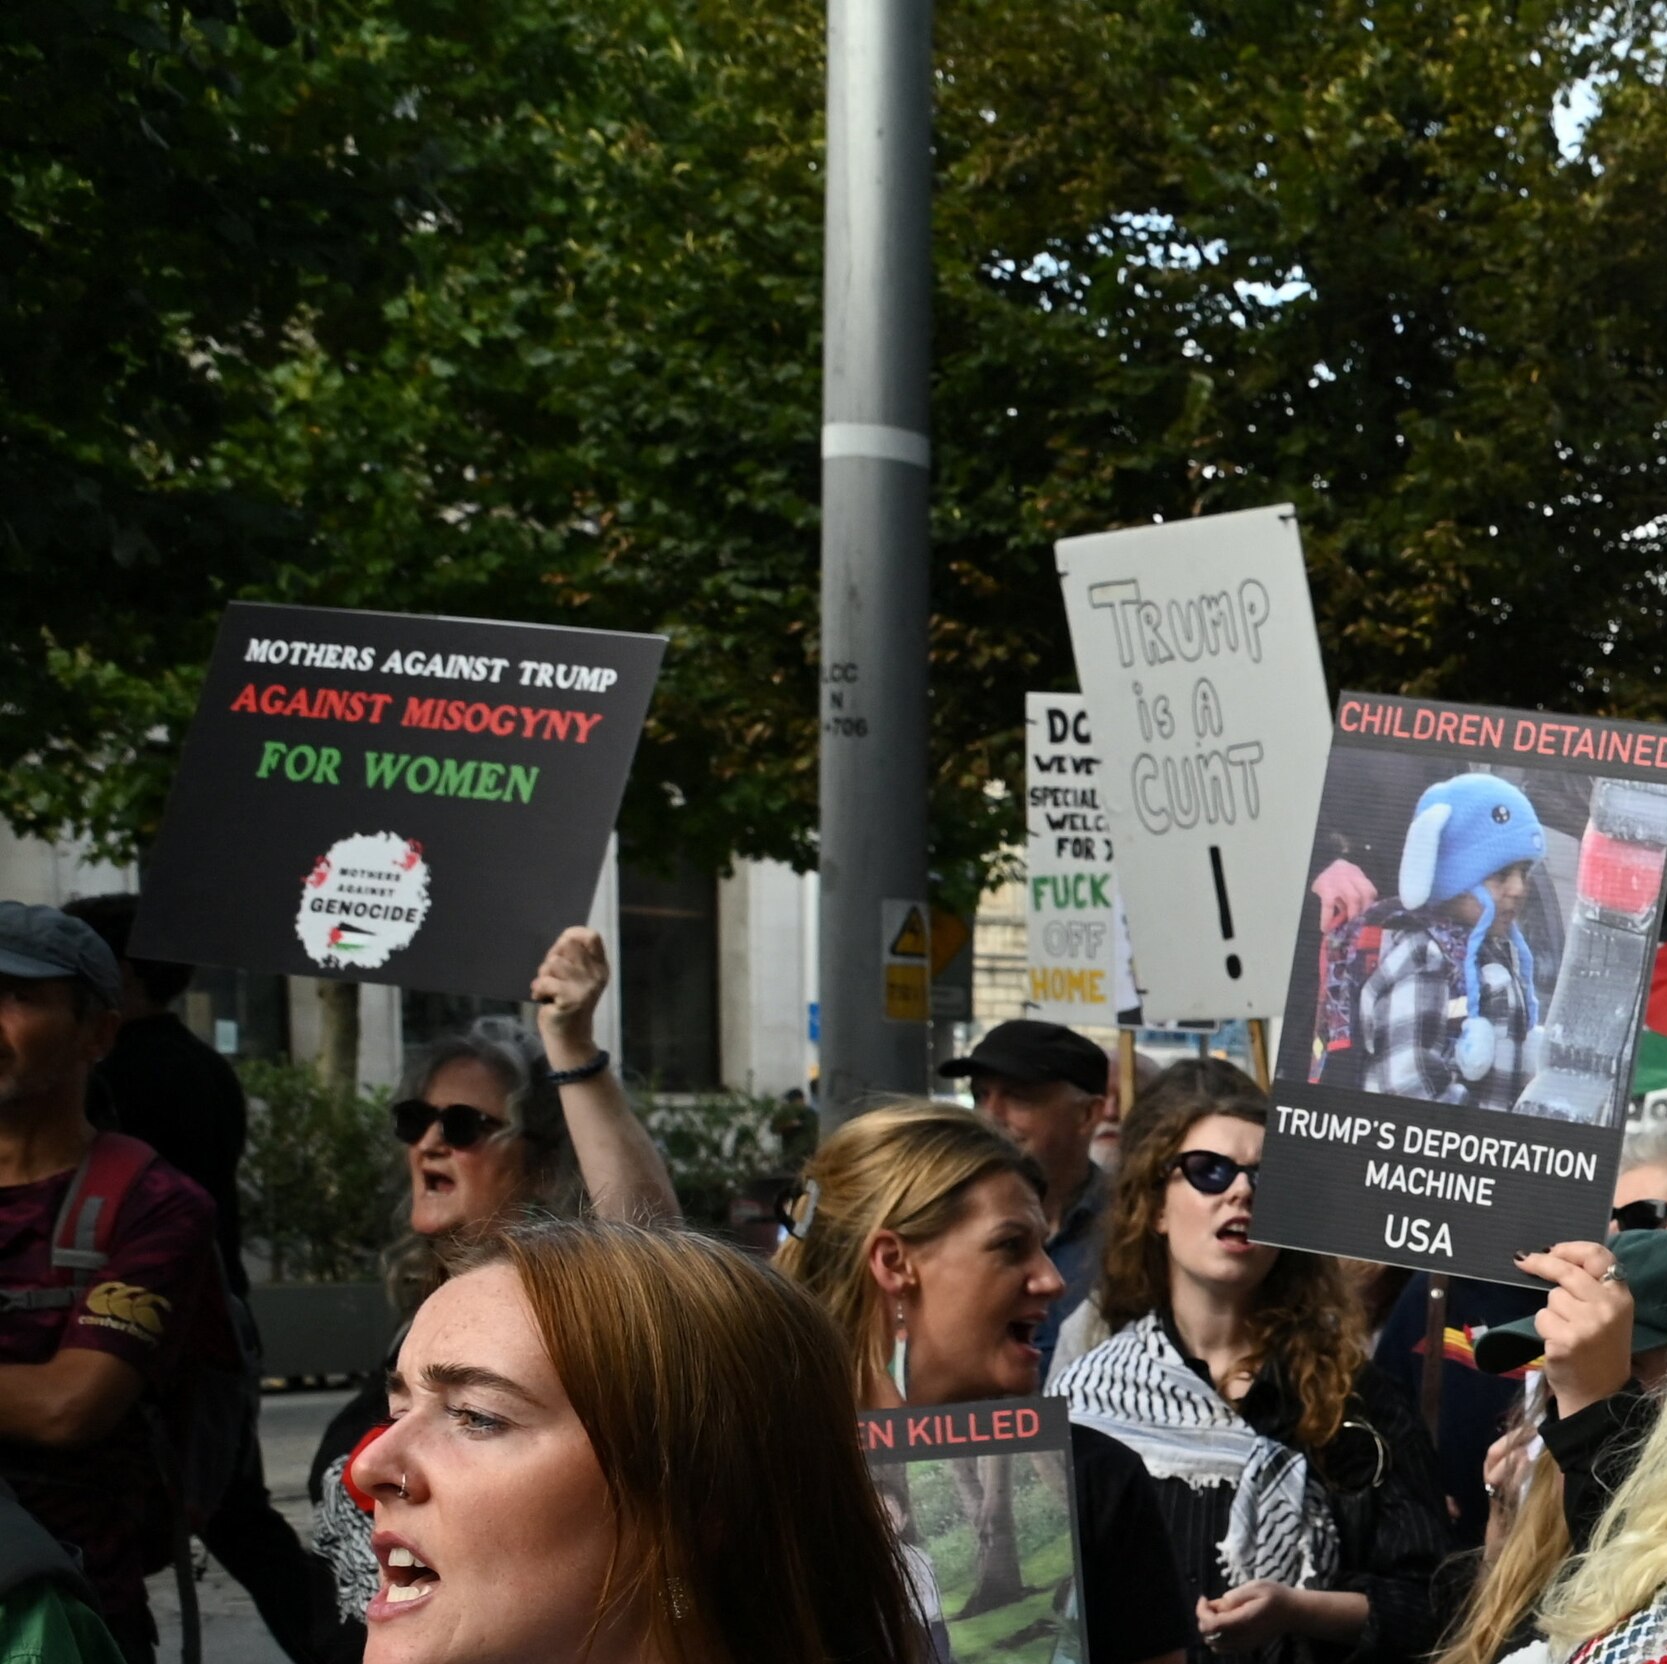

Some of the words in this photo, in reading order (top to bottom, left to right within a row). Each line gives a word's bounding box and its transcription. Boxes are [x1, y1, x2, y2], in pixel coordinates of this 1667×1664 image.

[1088, 578, 1270, 668] TRUMP
[245, 638, 375, 671] MOTHERS
[381, 650, 509, 683] AGAINST
[519, 661, 618, 693] TRUMP
[230, 683, 392, 724] AGAINST
[402, 697, 603, 744] MISOGYNY
[1339, 701, 1504, 749] CHILDREN
[256, 741, 341, 785] FOR
[364, 751, 540, 804] WOMEN
[1130, 740, 1265, 835] CUNT
[1030, 787, 1099, 809] SPECIAL
[1046, 813, 1110, 833] WELC
[1056, 838, 1096, 861] FOR
[339, 868, 401, 882] MOTHERS
[1031, 873, 1112, 912] FUCK
[310, 898, 420, 924] GENOCIDE
[1042, 920, 1107, 959] OFF
[1030, 967, 1107, 1004] HOME
[1276, 1105, 1396, 1150] TRUMP'S
[1402, 1125, 1597, 1182] DEPORTATION
[1365, 1160, 1496, 1207] MACHINE
[1384, 1213, 1453, 1257] USA
[907, 1408, 1040, 1446] KILLED
